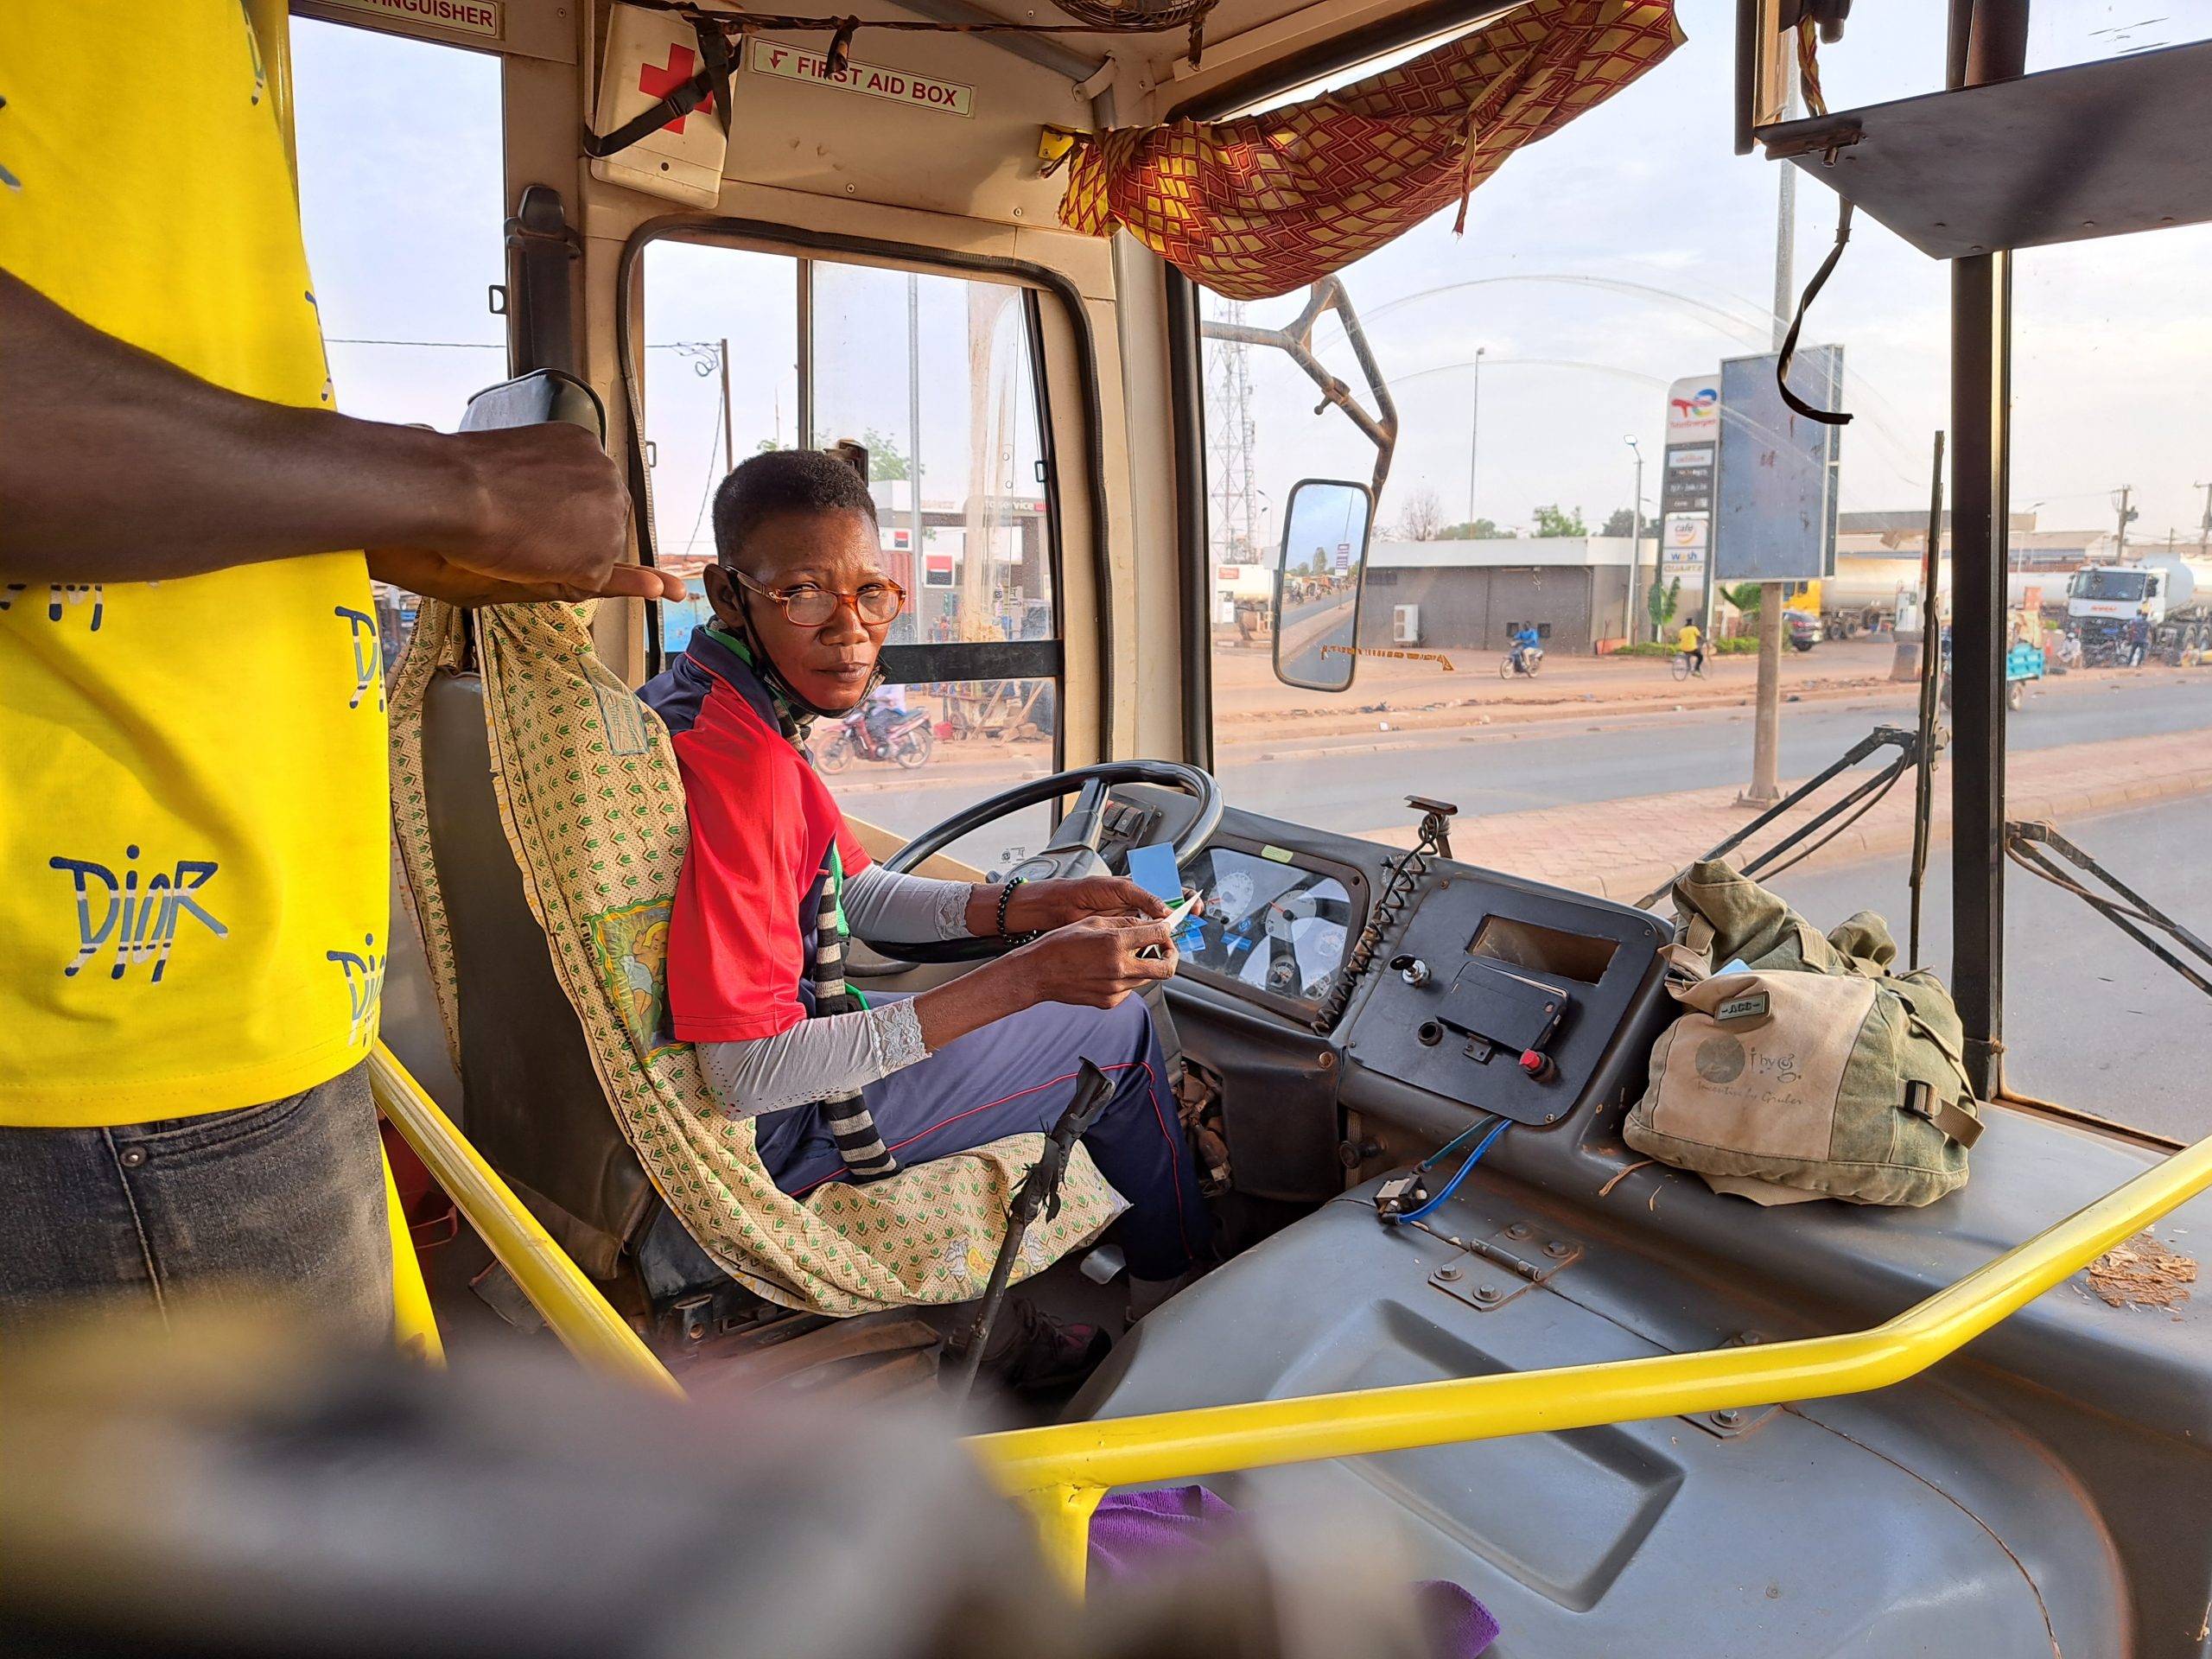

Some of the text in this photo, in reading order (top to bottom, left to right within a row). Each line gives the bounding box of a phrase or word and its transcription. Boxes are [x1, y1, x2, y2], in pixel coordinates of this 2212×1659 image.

[867, 73, 905, 95] AID
[912, 83, 957, 106] BOX
[1671, 550, 1698, 561] wash
